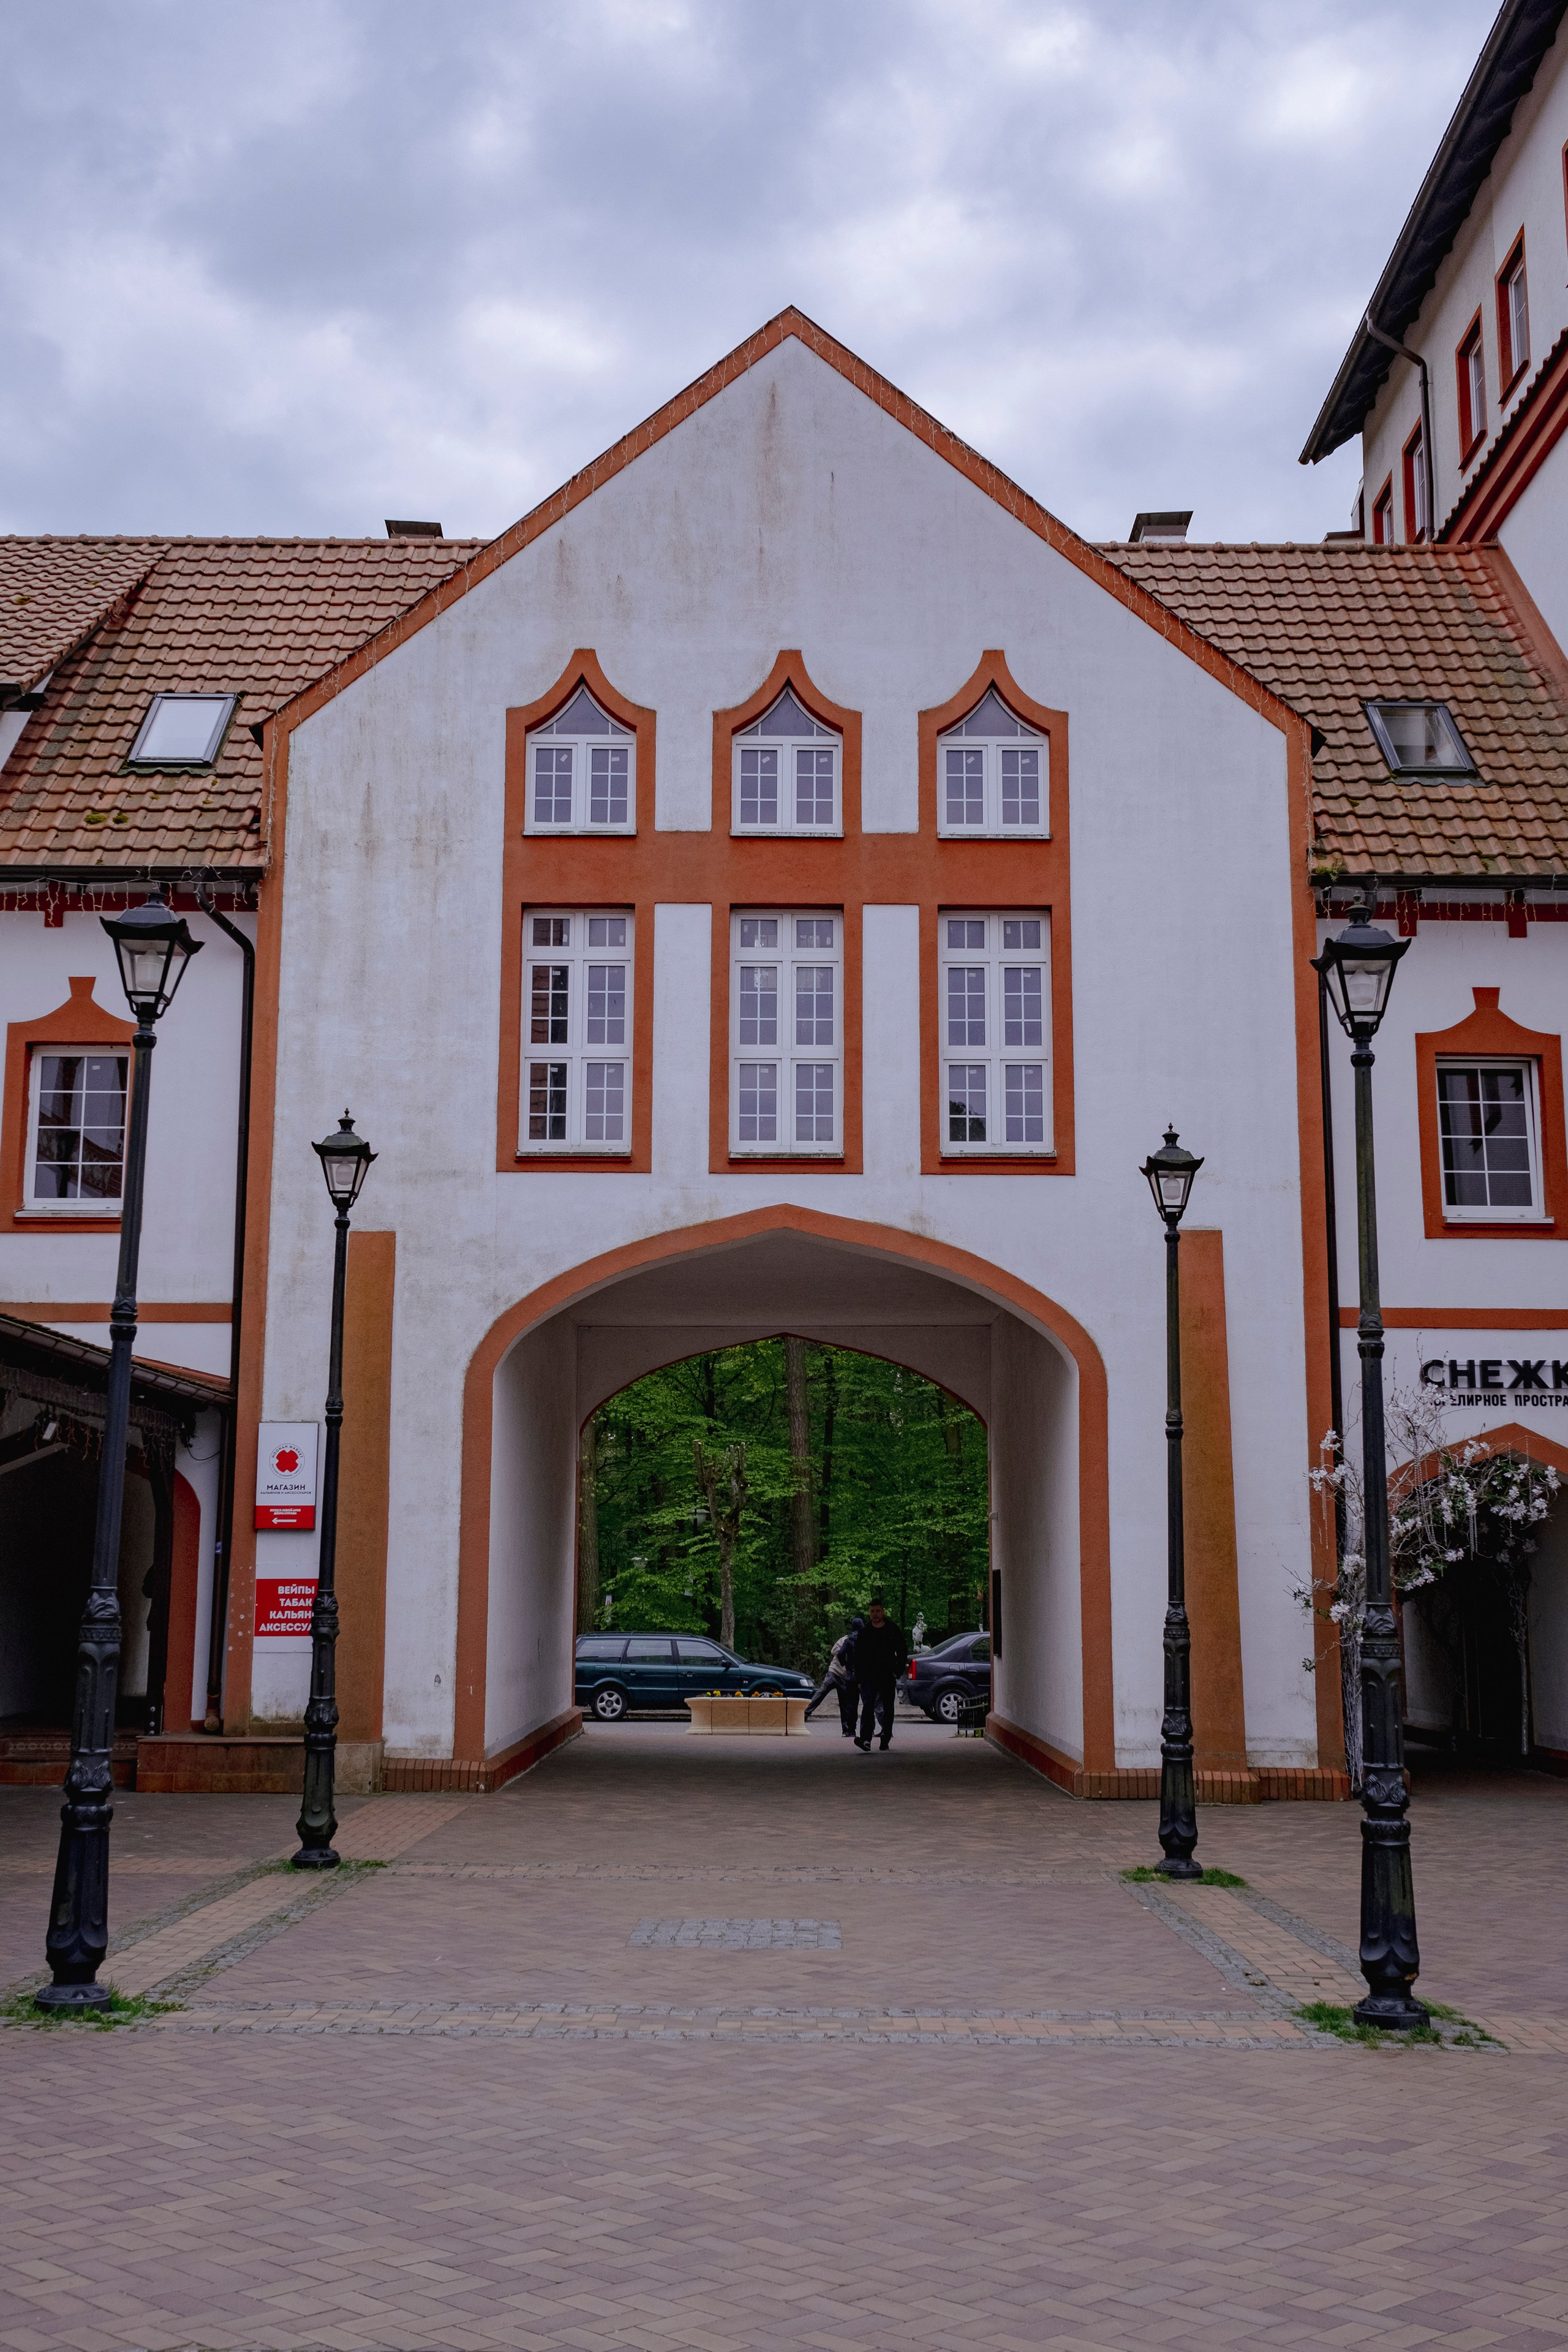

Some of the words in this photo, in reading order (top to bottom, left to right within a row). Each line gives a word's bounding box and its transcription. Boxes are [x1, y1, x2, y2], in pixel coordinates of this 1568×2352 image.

[1420, 1360, 1568, 1389] СНЕЖК
[277, 1583, 315, 1594] ВЕЙПЫ
[279, 1598, 312, 1607] ТАБАК
[270, 1610, 314, 1619] КАЛЬЯН
